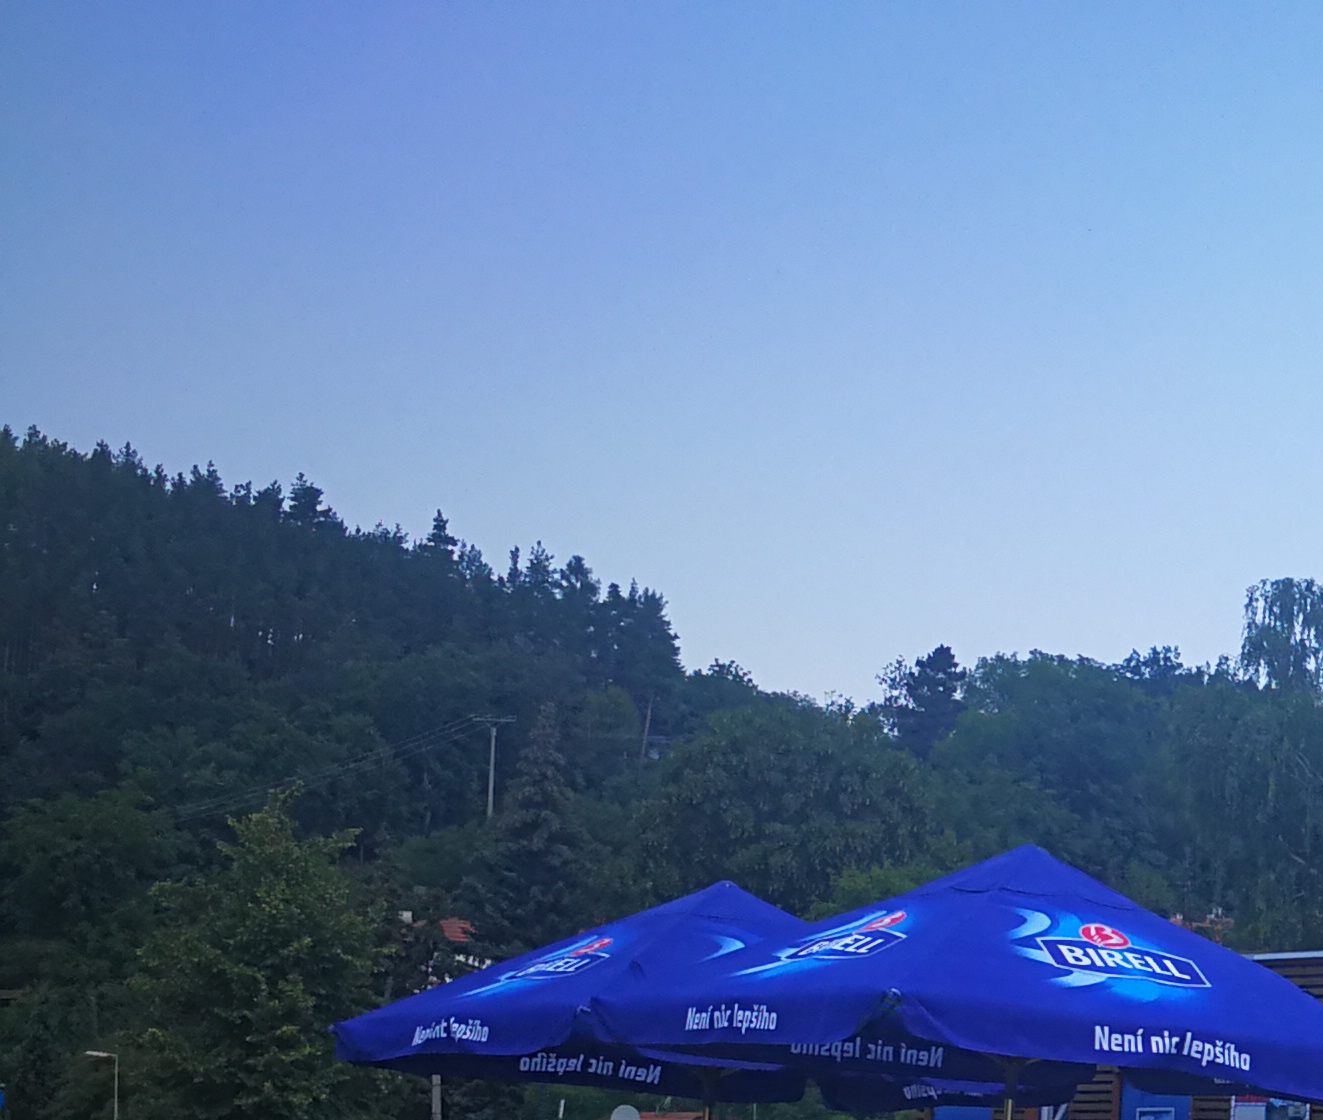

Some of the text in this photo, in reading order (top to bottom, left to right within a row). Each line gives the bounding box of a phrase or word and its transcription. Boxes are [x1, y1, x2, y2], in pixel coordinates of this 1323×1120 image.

[1057, 944, 1191, 981] BIRELL
[685, 1003, 778, 1034] Není nic lepšího
[1093, 1024, 1252, 1072] Není nic lepšího
